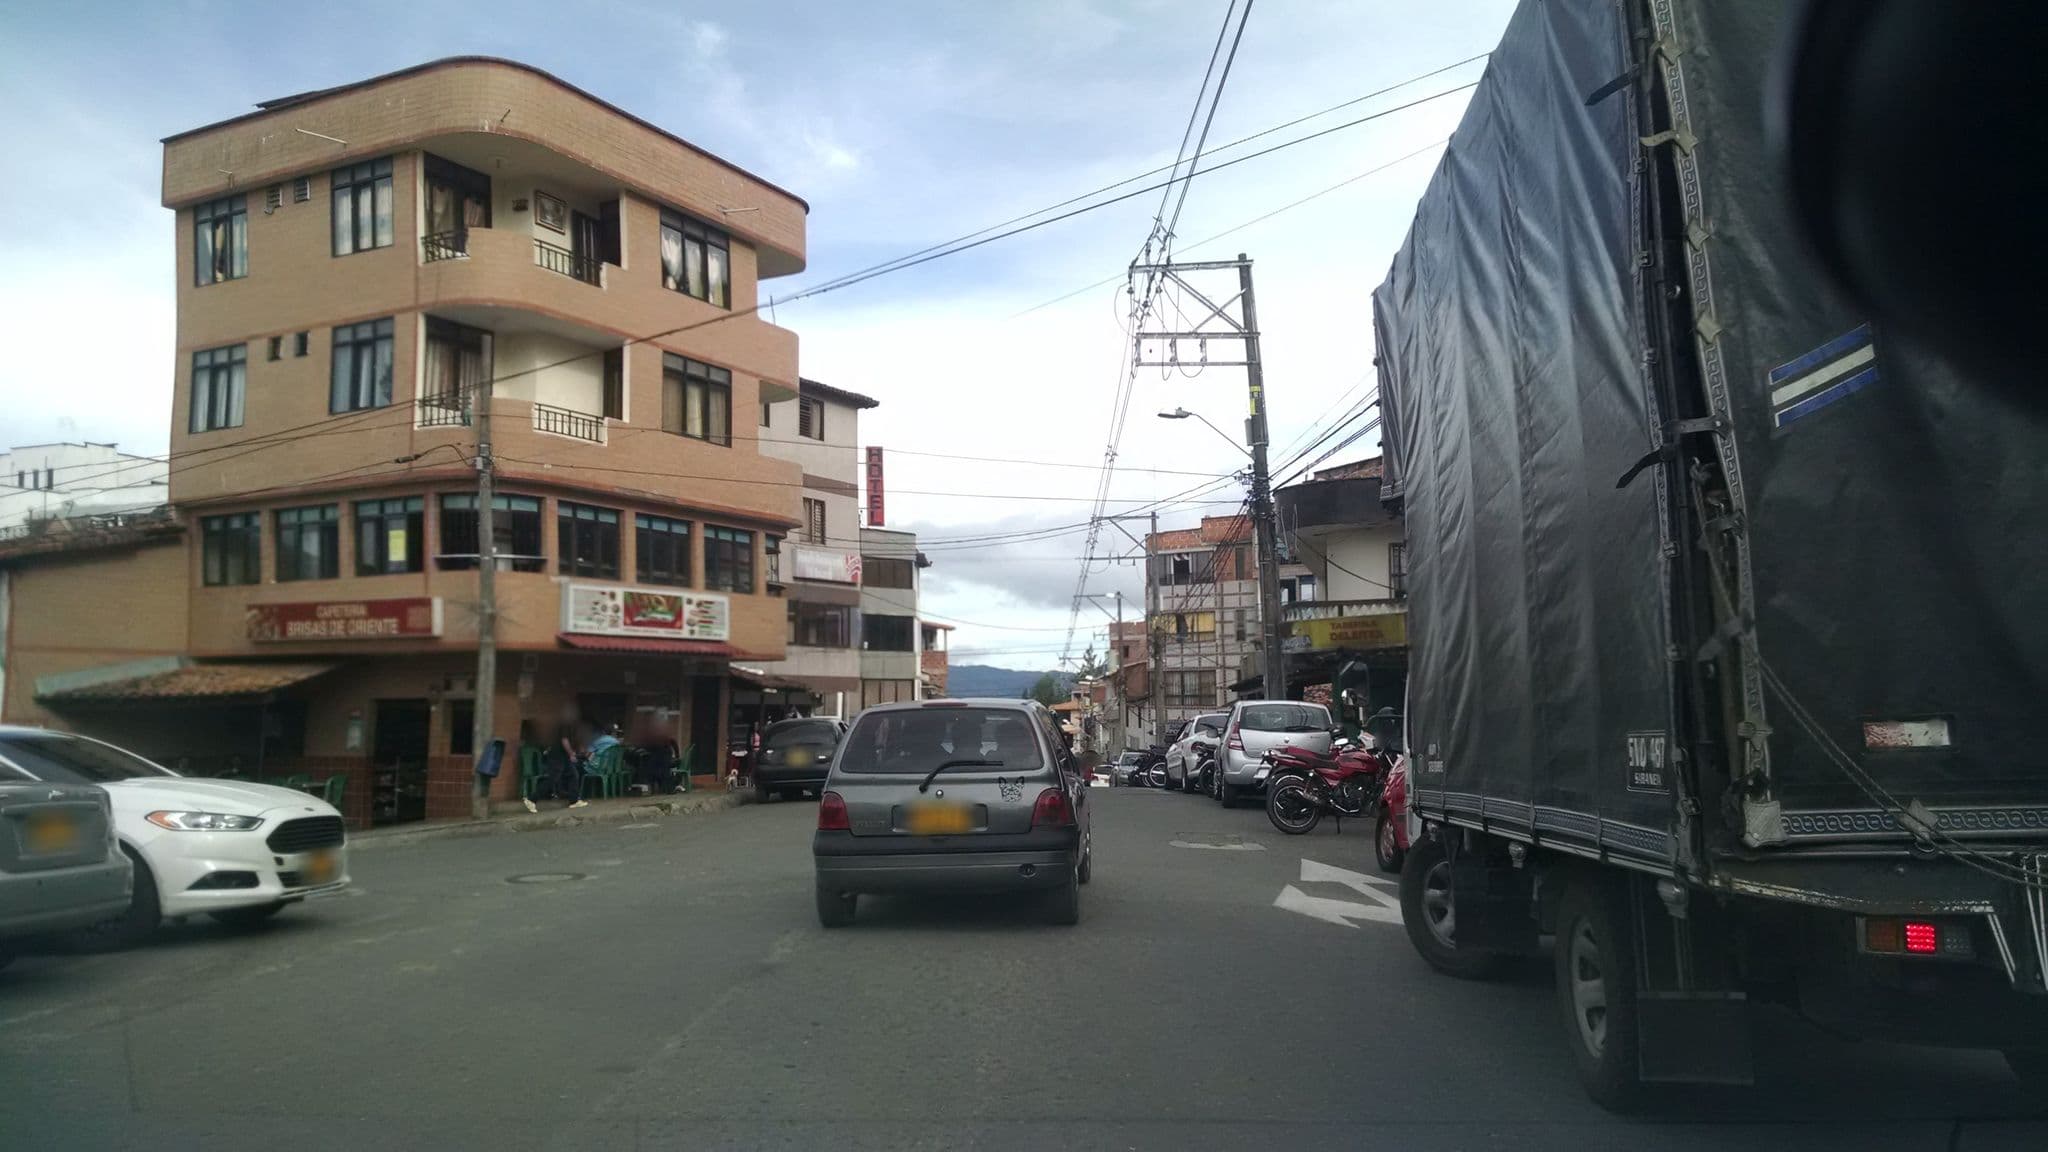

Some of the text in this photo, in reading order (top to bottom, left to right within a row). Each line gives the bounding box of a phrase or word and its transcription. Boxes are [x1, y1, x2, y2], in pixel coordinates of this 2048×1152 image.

[868, 448, 882, 524] HOTEL
[316, 604, 368, 618] CAFETERIA
[287, 618, 399, 636] BRISAS DE ORIENTE
